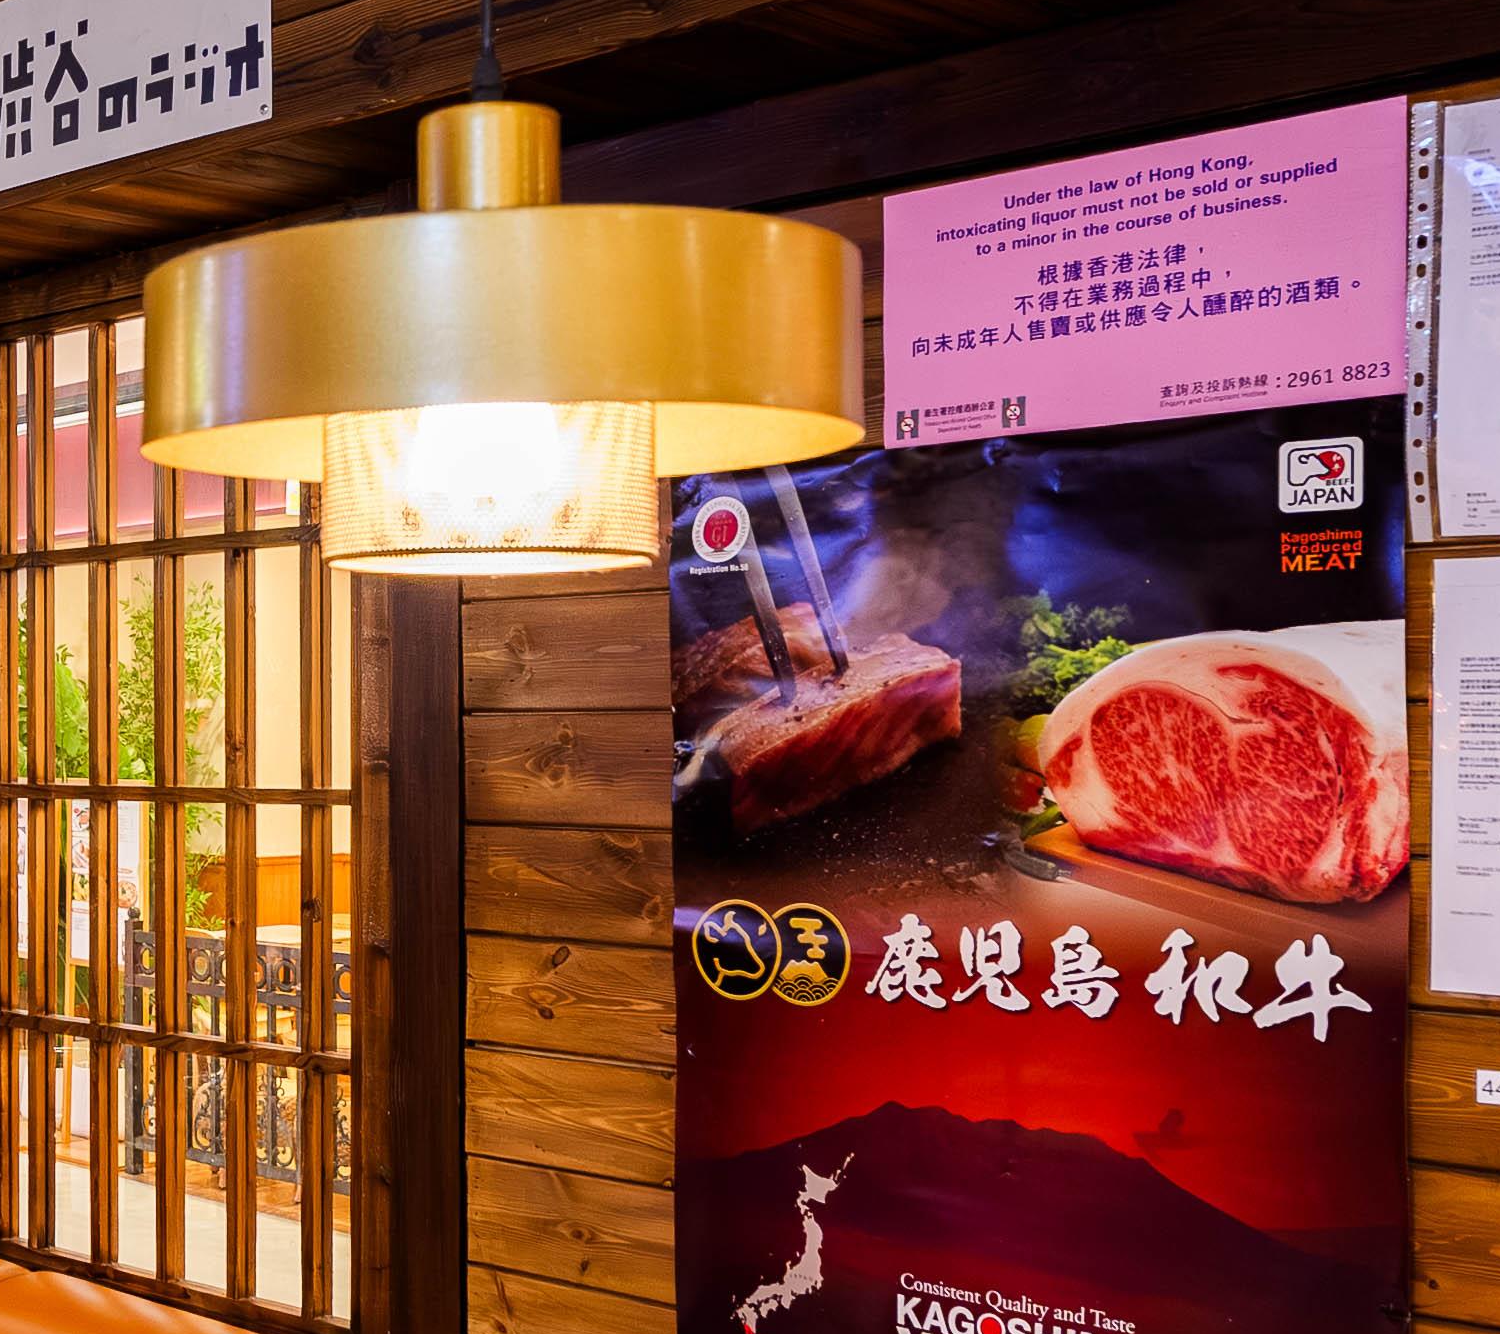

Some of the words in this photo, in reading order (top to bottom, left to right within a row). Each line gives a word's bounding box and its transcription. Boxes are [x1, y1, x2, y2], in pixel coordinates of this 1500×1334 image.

[1003, 189, 1051, 209] Under
[1057, 184, 1083, 202] the
[1088, 177, 1118, 196] law
[1125, 170, 1142, 189] of
[1149, 162, 1195, 183] Hong
[1201, 153, 1253, 175] Kong,
[936, 215, 1026, 243] intoxicating
[1031, 207, 1076, 229] liquor
[1082, 199, 1124, 219] must
[1129, 191, 1158, 210] not
[1165, 184, 1186, 203] be
[1192, 178, 1229, 199] sold
[1235, 174, 1253, 189] or
[1259, 158, 1338, 187] supplied
[976, 242, 992, 256] to
[997, 239, 1008, 253] a
[1012, 228, 1057, 251] minor
[1061, 227, 1077, 242] in
[1083, 220, 1110, 238] the
[1115, 210, 1172, 233] course
[1178, 205, 1197, 223] of
[1202, 192, 1288, 219] business.
[1342, 361, 1391, 382] 8823
[1326, 478, 1350, 486] BEEF
[1288, 486, 1354, 506] JAPAN
[1281, 529, 1362, 544] Kagoshima
[1281, 540, 1362, 554] Produced
[1281, 552, 1362, 572] MEAT
[900, 1272, 982, 1305] Consistent
[985, 1289, 1049, 1322] Quality
[1053, 1307, 1085, 1326] and
[1089, 1309, 1136, 1334] Taste
